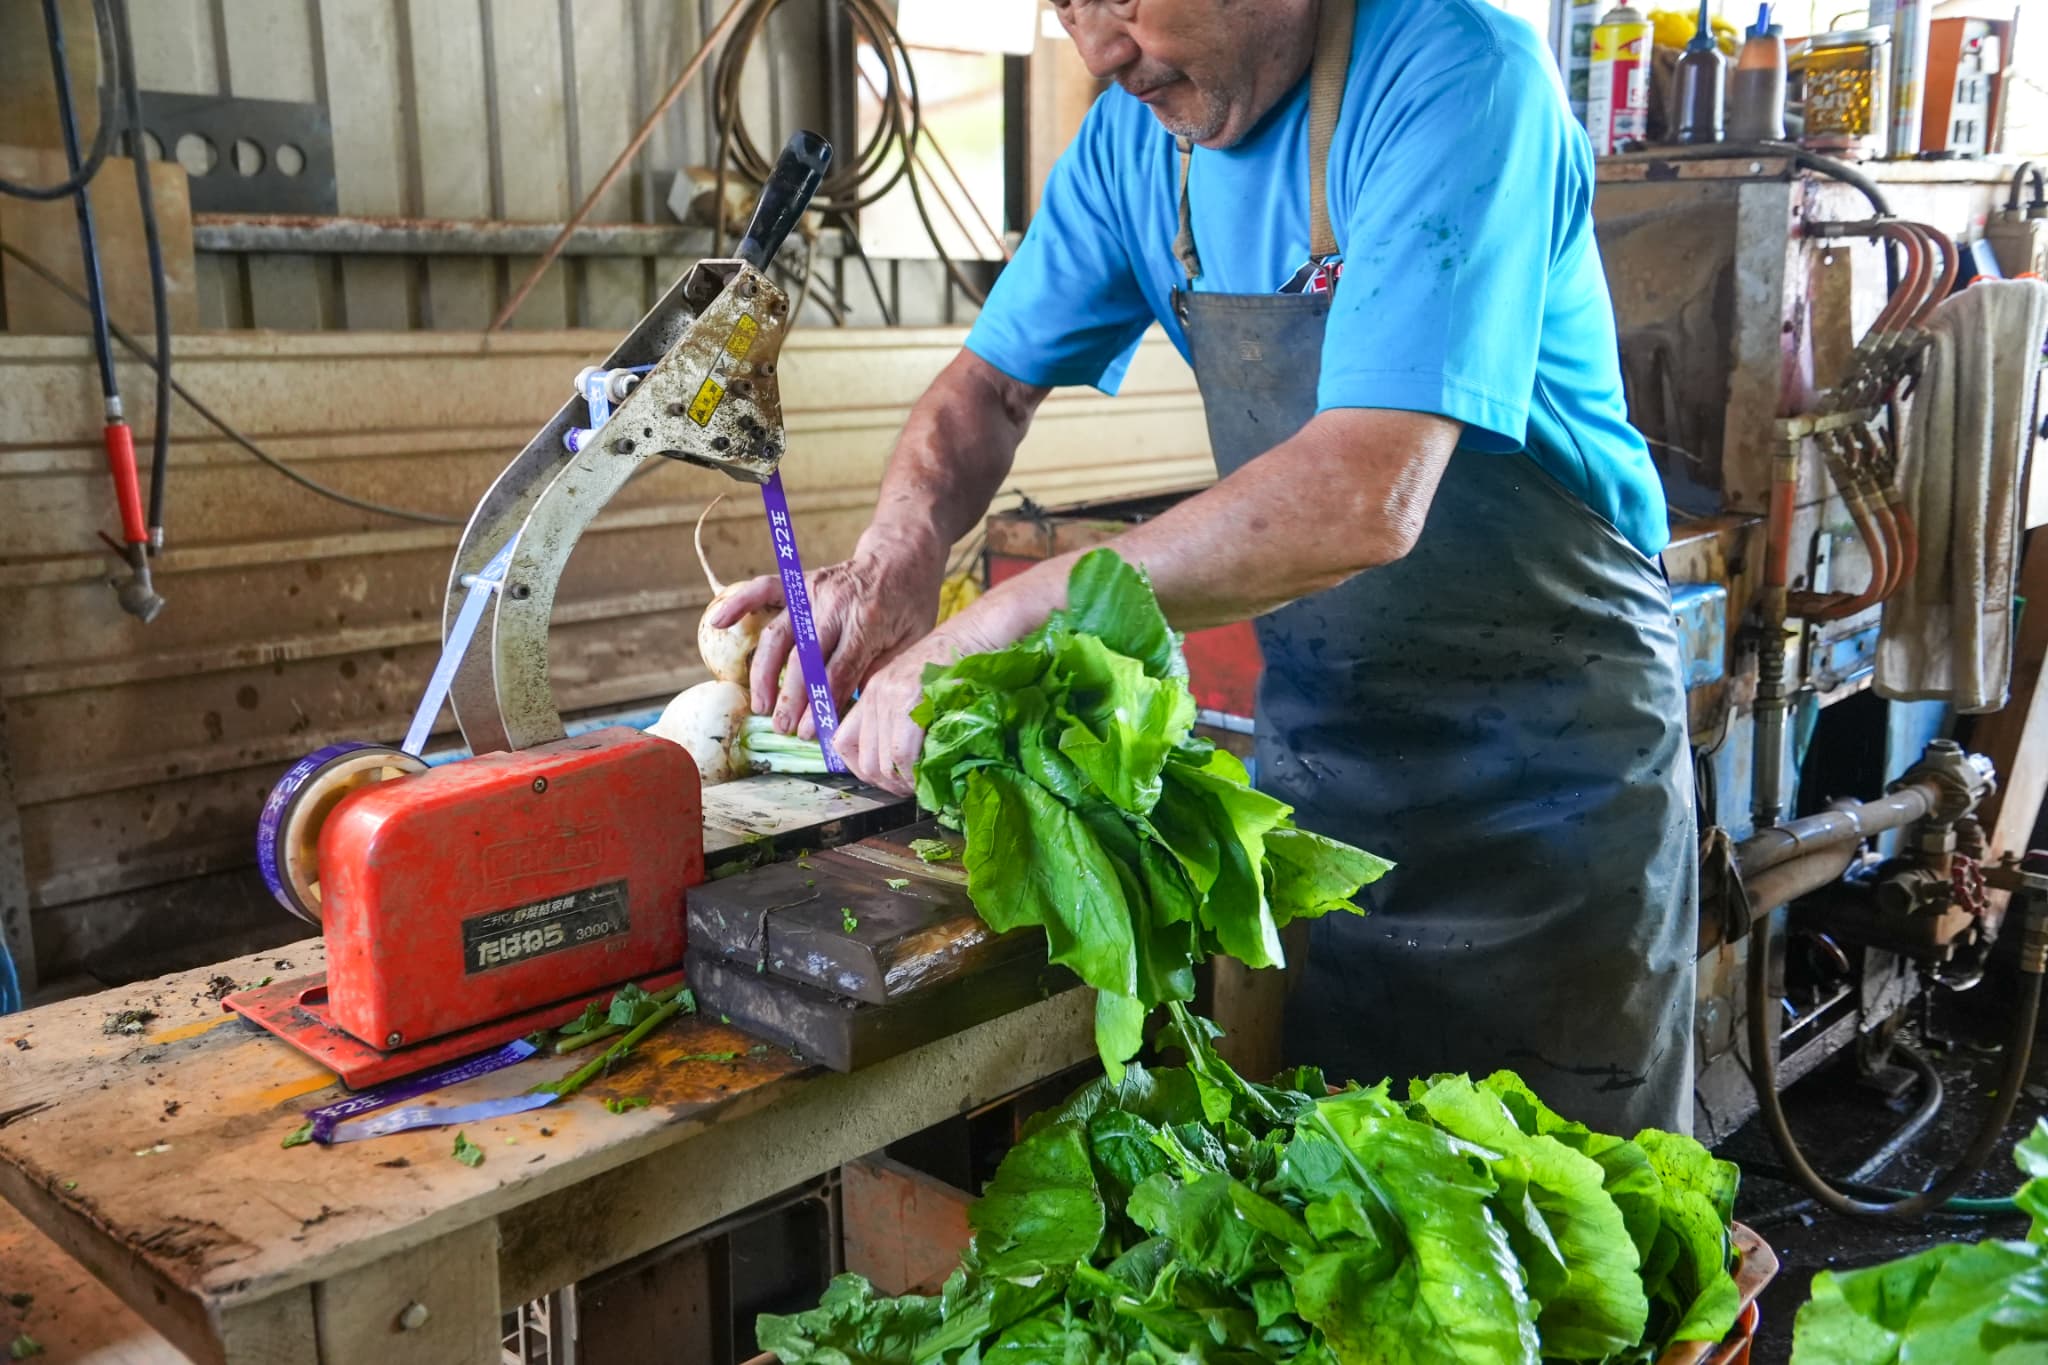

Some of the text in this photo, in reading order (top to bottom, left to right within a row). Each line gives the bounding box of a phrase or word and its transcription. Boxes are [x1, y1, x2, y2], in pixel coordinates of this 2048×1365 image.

[770, 509, 794, 561] 玉乙女
[810, 683, 834, 730] 玉乙女
[478, 922, 566, 966] たばねら
